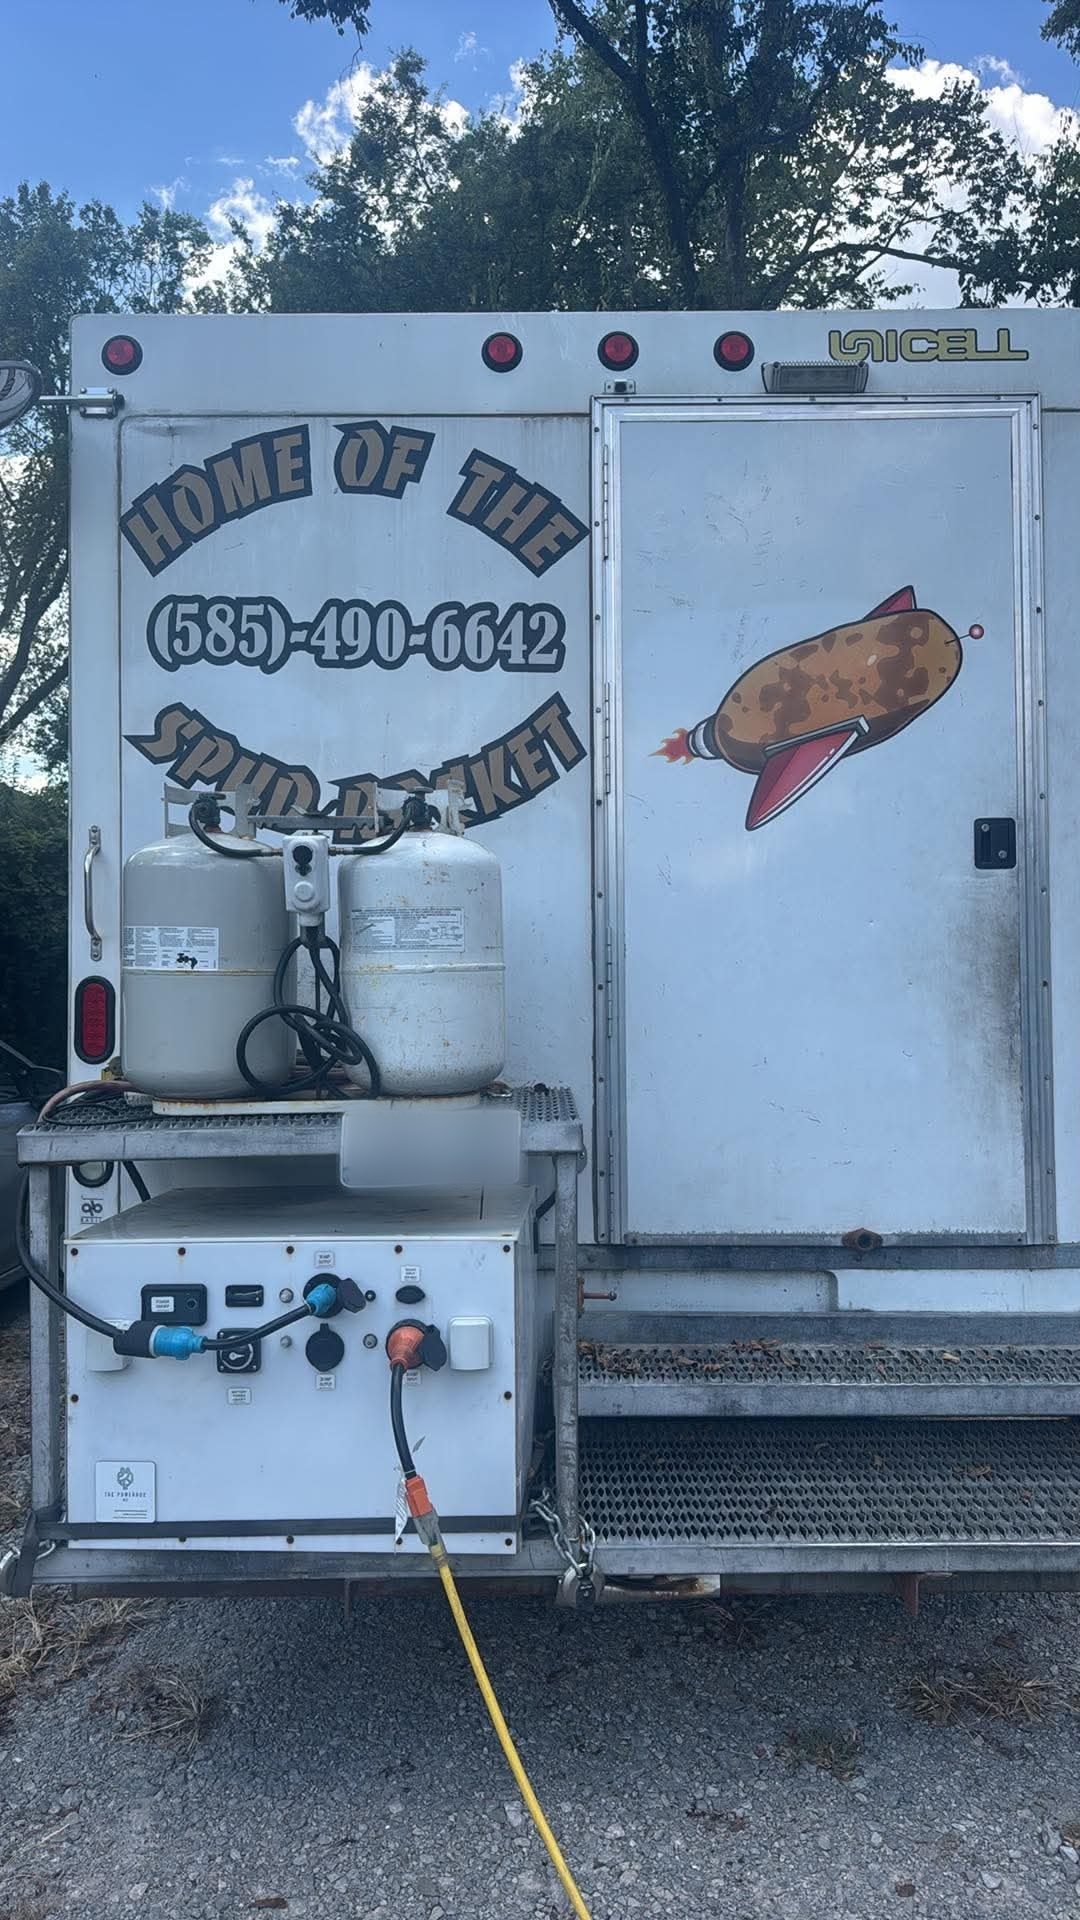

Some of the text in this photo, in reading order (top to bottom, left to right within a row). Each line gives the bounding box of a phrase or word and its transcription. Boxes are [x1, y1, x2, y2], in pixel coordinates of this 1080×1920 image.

[828, 328, 1029, 362] UNICELL
[119, 420, 591, 577] HOME OF THE
[147, 595, 566, 674] (585)-490-6642
